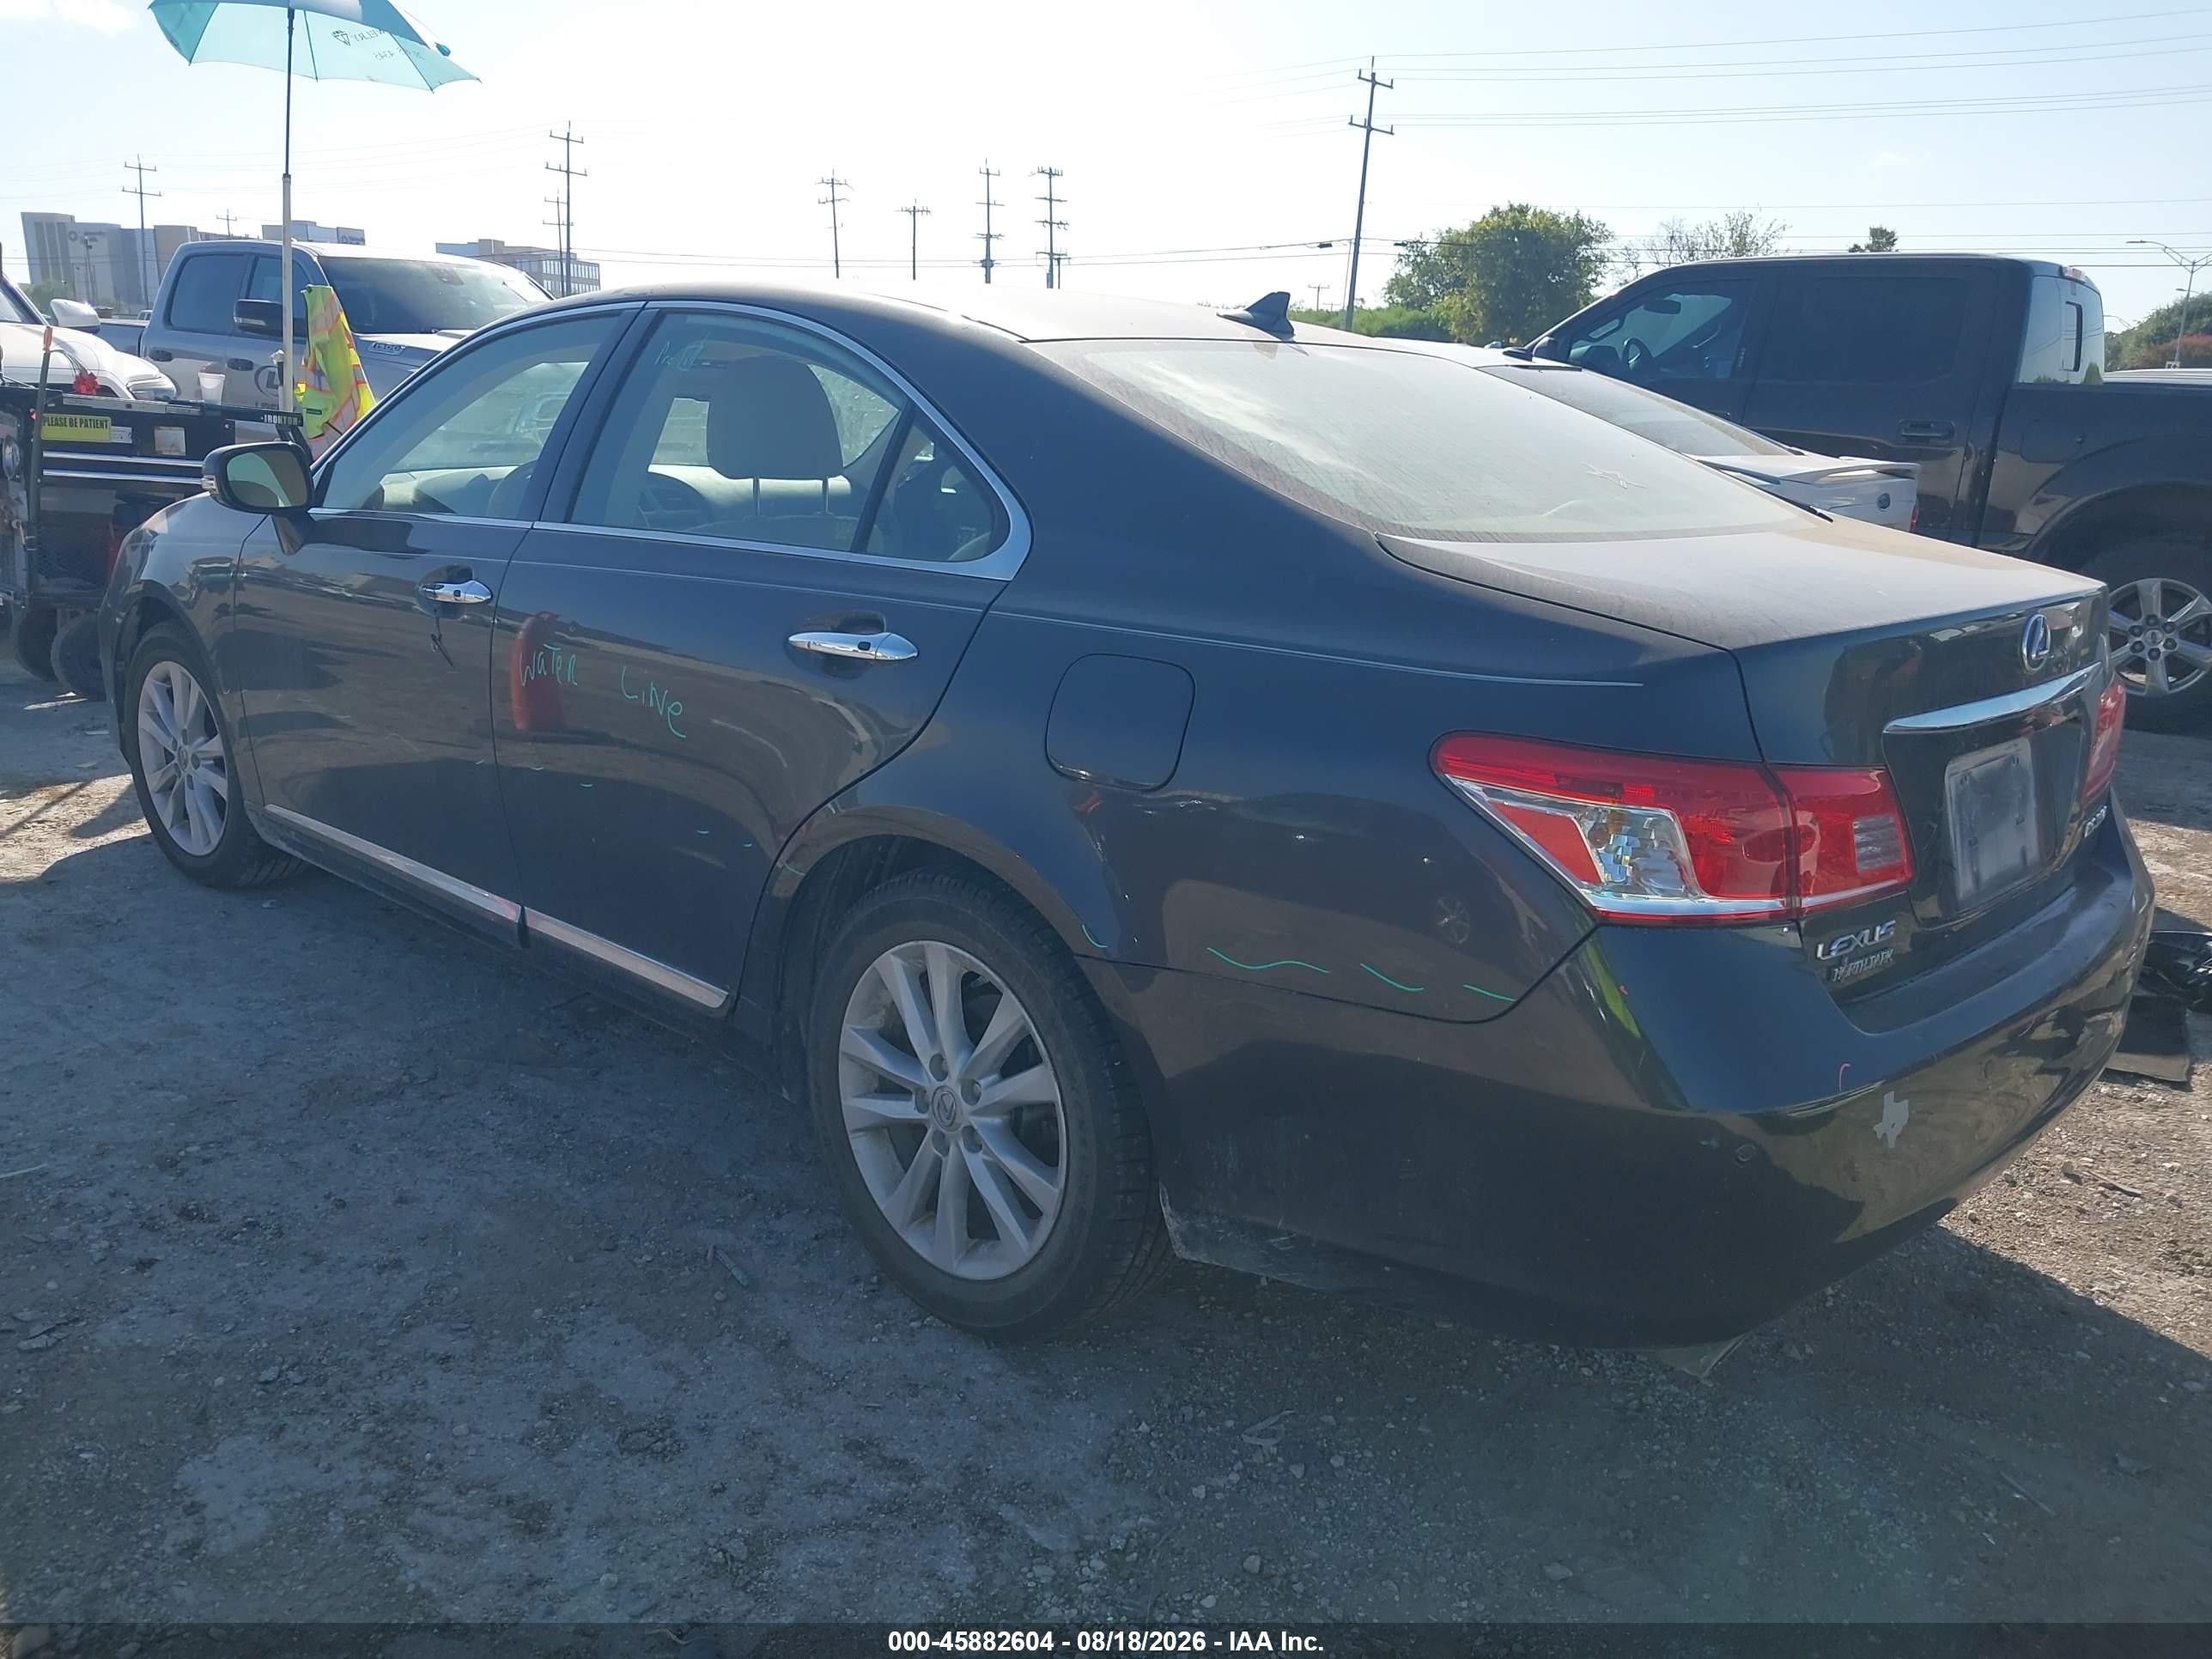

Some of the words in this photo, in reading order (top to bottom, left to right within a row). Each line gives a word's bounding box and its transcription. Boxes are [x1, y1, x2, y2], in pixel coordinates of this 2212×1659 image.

[43, 416, 67, 428] PLEASE
[69, 417, 78, 428] BE
[79, 417, 108, 429] PATIENT
[1816, 920, 1896, 961] LEXUS
